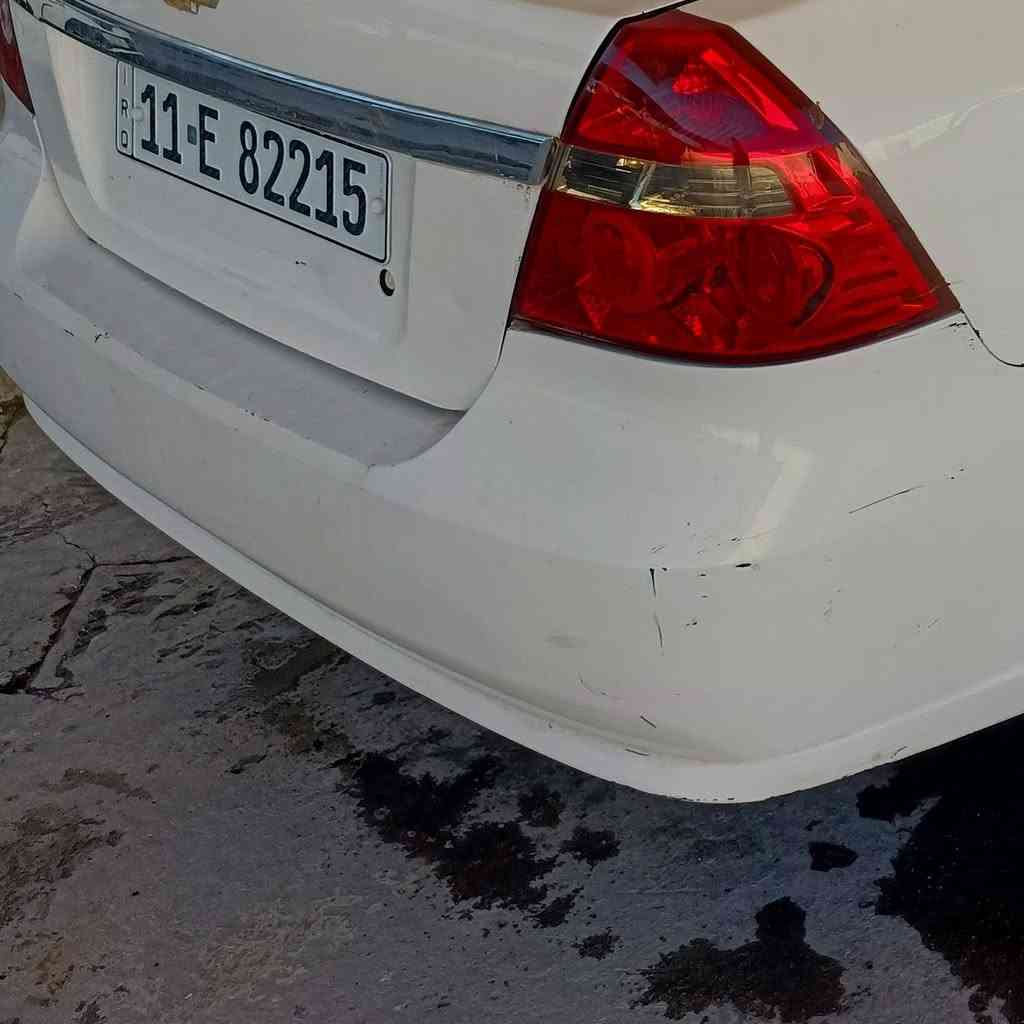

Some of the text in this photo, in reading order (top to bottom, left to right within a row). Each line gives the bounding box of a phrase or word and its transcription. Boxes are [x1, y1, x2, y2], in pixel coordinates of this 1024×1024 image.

[141, 84, 367, 236] 11 E 82215
